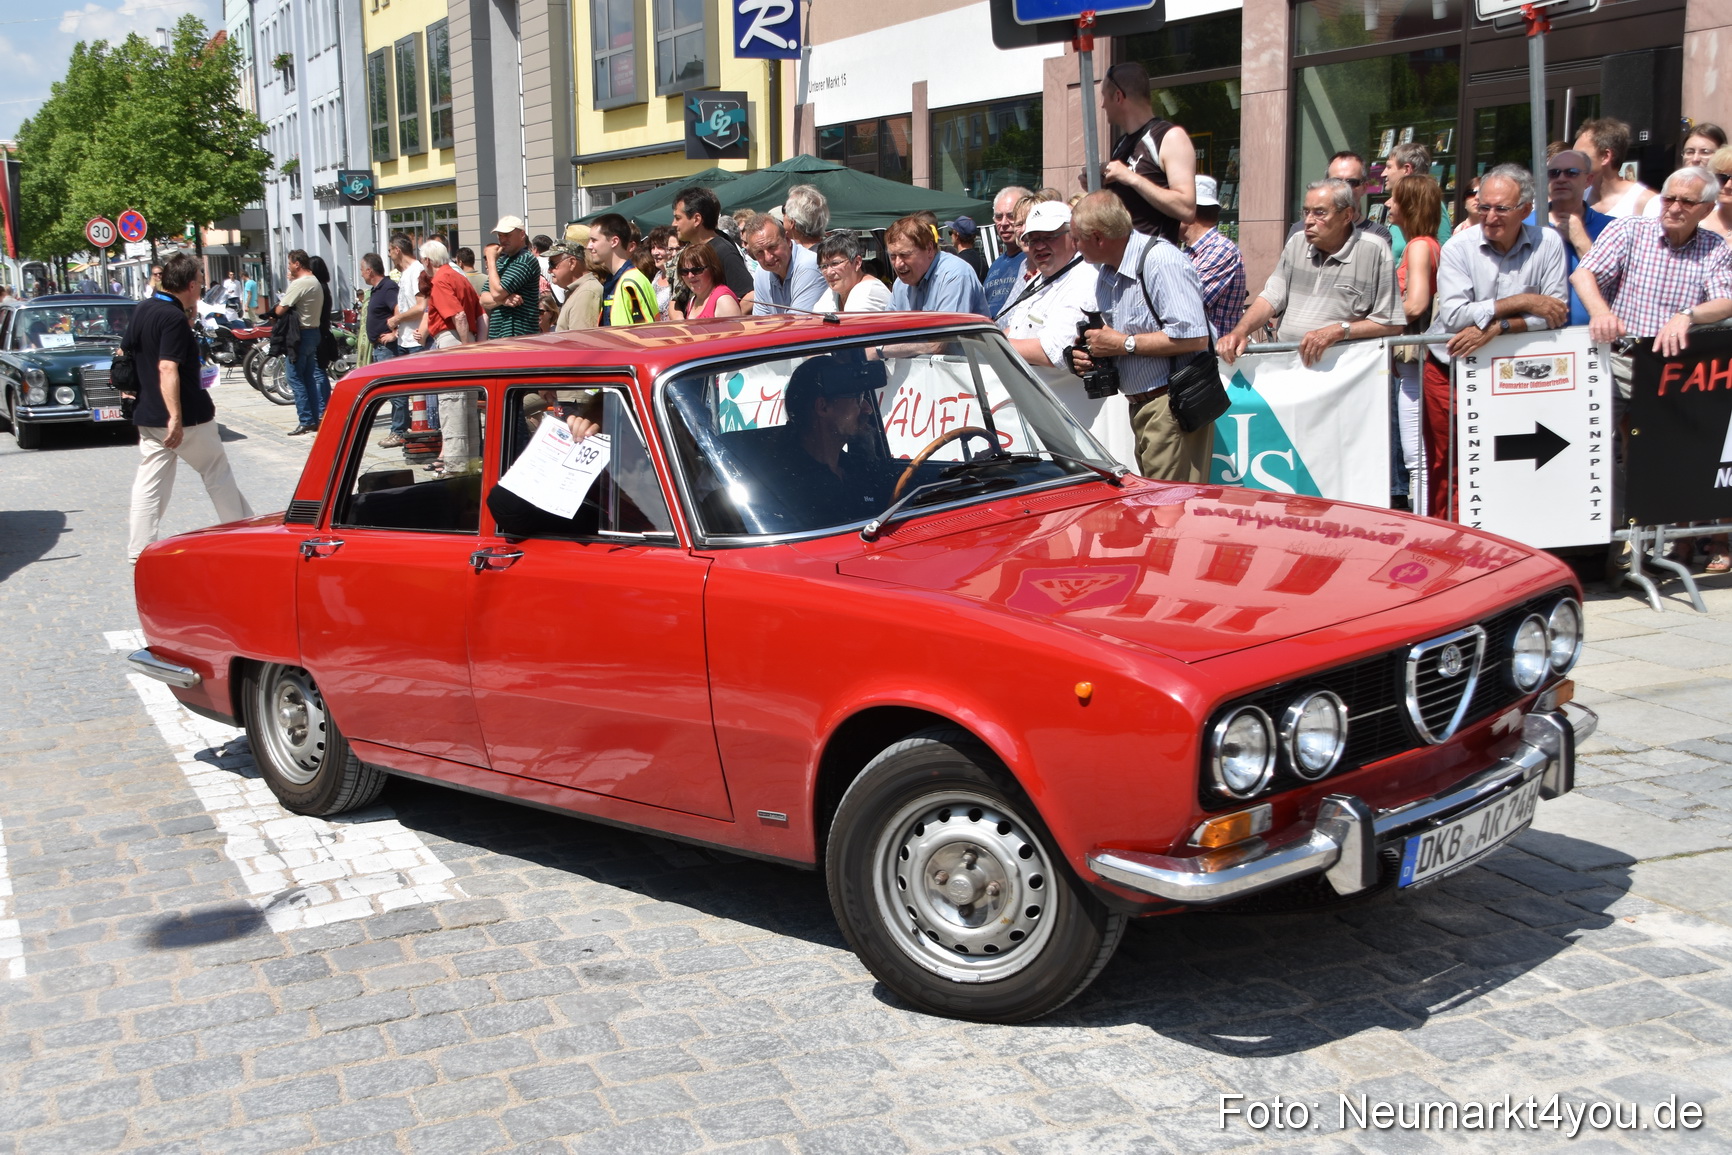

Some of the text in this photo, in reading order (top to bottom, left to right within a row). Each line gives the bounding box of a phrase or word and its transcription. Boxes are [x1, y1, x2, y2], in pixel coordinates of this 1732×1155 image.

[808, 73, 847, 93] Unterer Markt 15
[710, 109, 731, 137] G2
[351, 180, 363, 194] G2
[92, 225, 110, 239] 30
[1498, 377, 1569, 389] Neumarkter Oldtimertreffen
[1465, 356, 1481, 530] RESIDENZPLATZ
[1588, 347, 1601, 521] RESIDENZPLATZ
[575, 446, 599, 465] 599
[1416, 824, 1463, 875] DKB
[1475, 803, 1505, 848] AR
[1504, 780, 1539, 831] 74H
[1403, 866, 1411, 877] D
